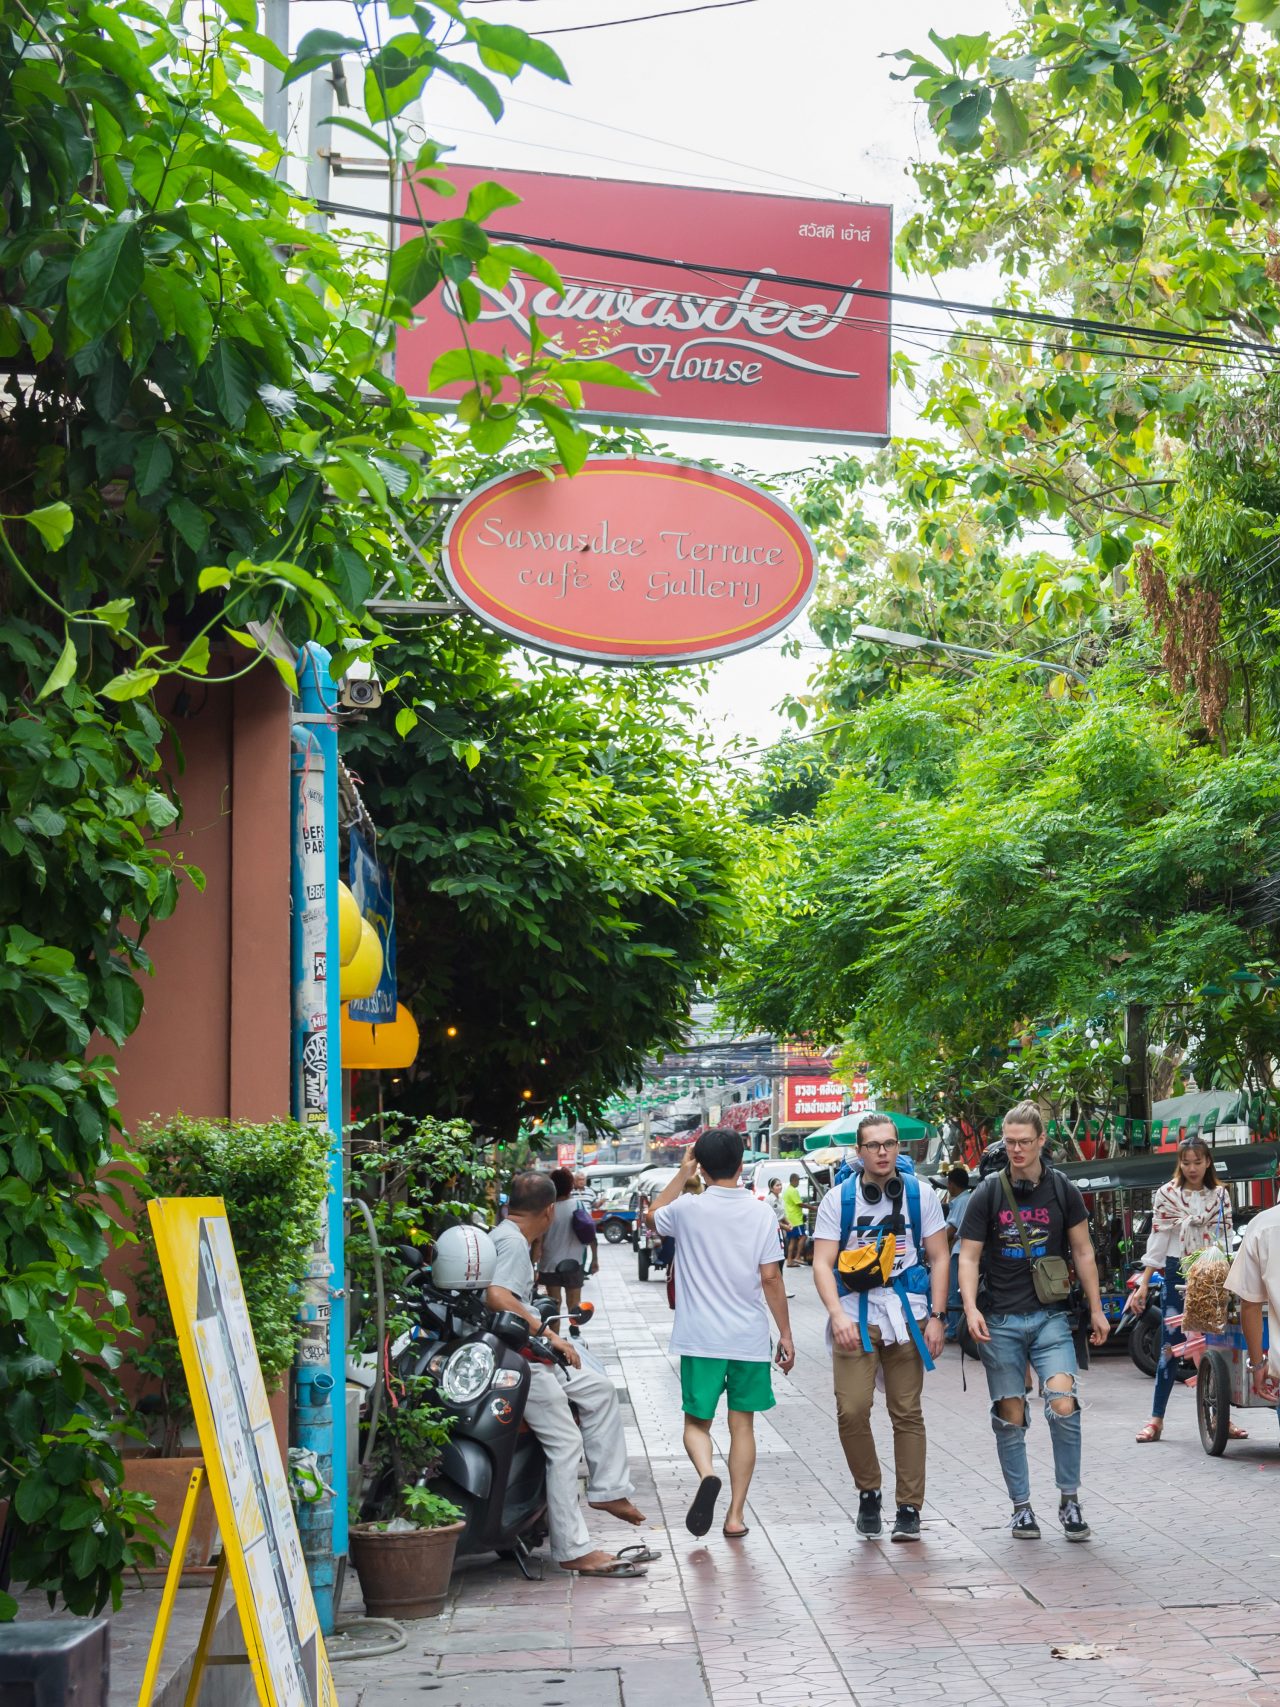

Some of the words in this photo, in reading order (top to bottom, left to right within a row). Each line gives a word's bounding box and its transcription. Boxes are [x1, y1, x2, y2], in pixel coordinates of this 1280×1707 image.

[798, 222, 835, 240] สวัสดี
[633, 341, 764, 385] House
[477, 518, 647, 557] Sawasdee
[659, 530, 785, 567] Terrace
[607, 567, 625, 593] &
[645, 568, 761, 608] Gallery
